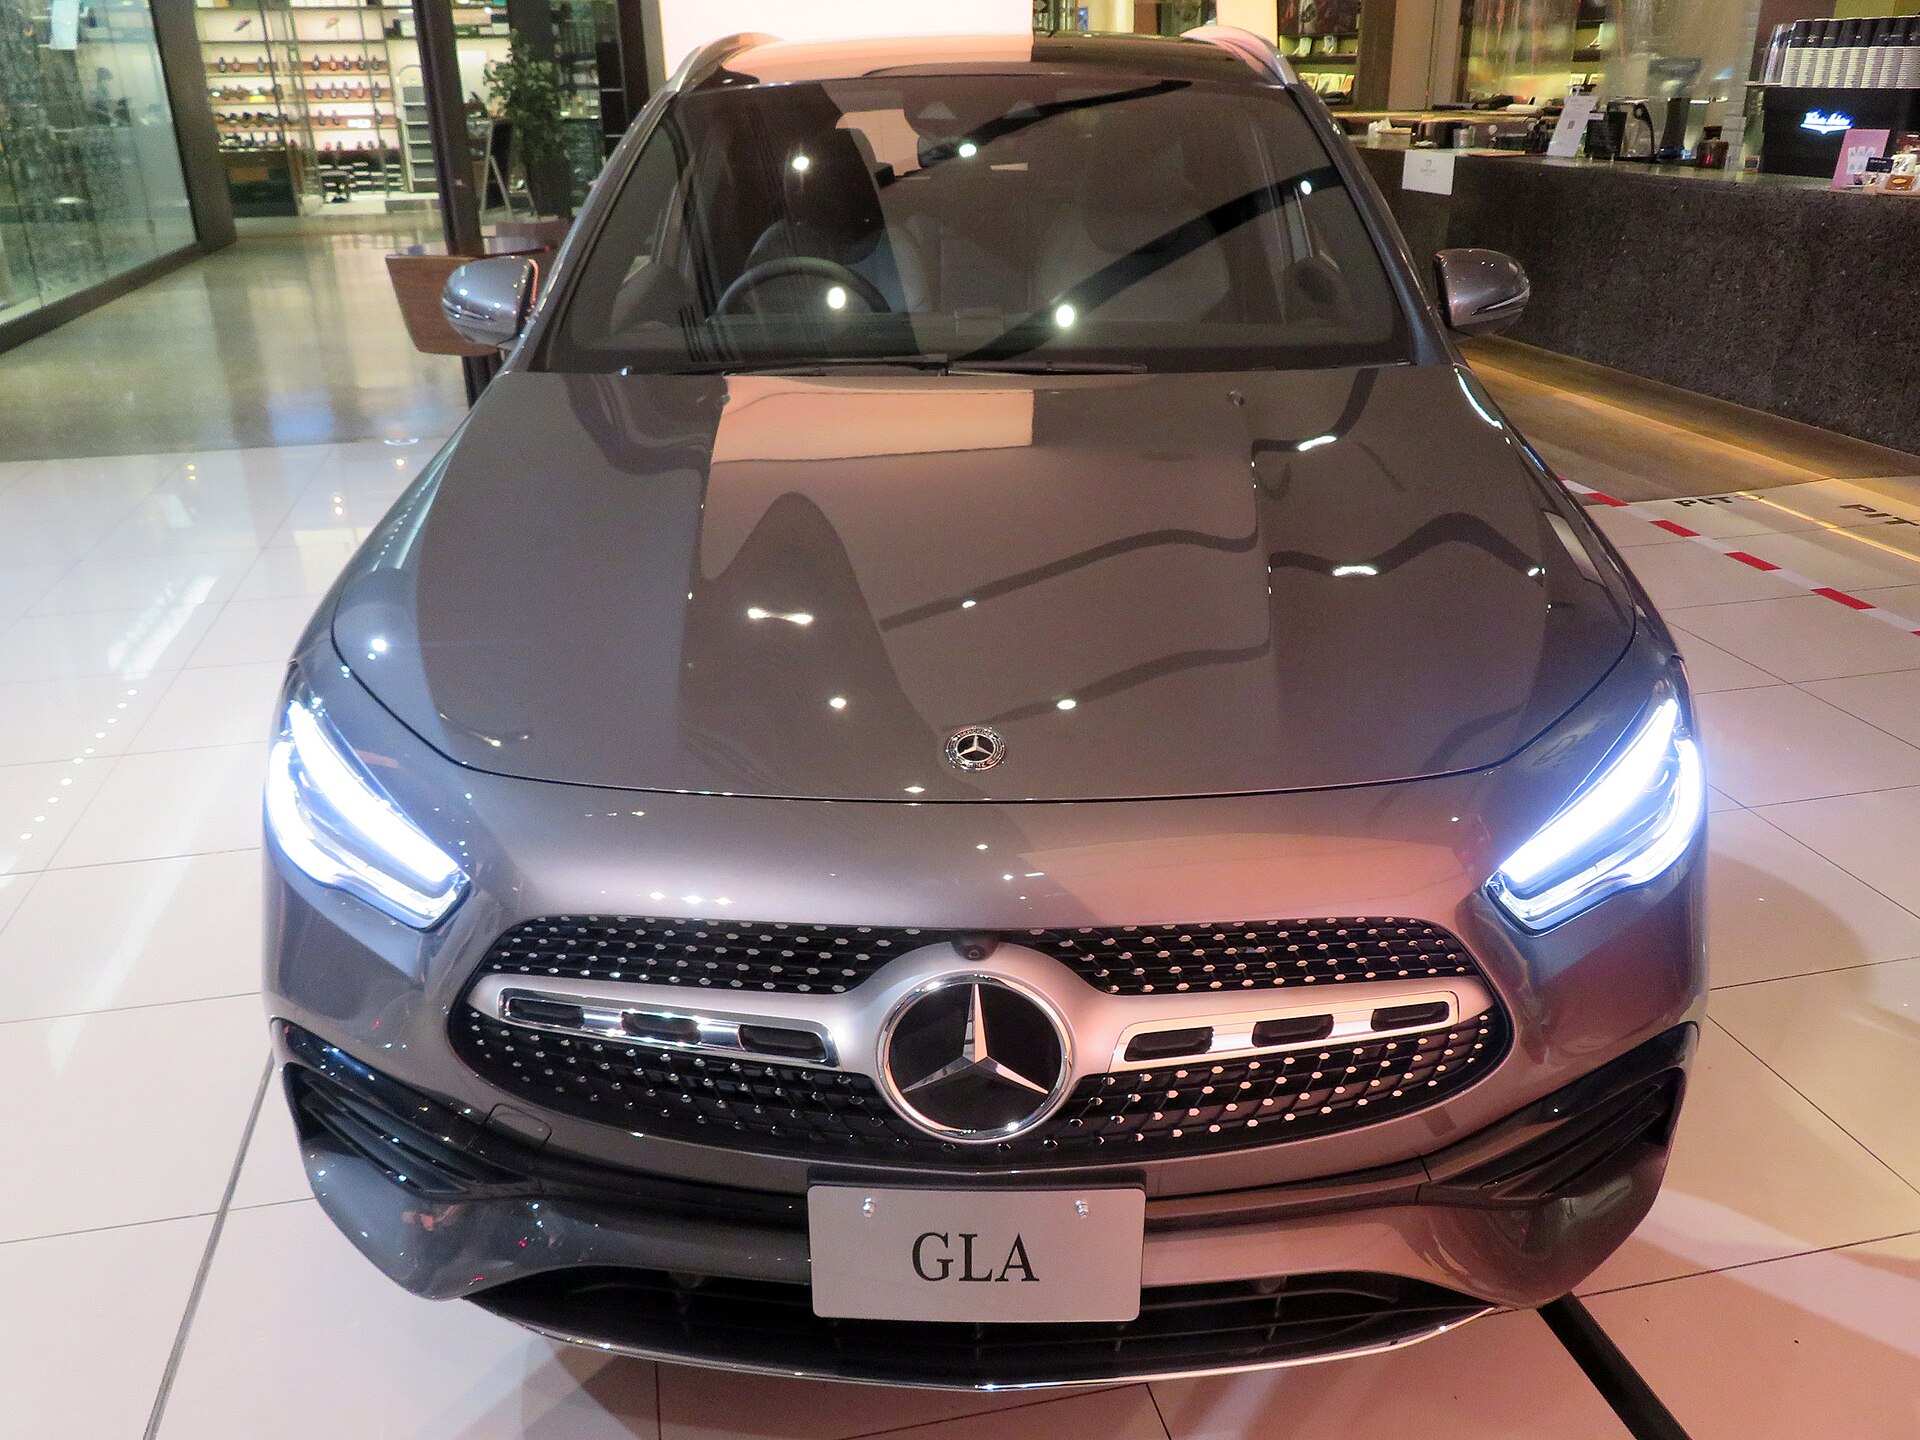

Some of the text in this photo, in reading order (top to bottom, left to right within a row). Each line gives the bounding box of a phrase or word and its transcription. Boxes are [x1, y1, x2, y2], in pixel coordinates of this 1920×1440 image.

[1673, 497, 1734, 508] PIT
[1839, 503, 1920, 527] PIT
[911, 1231, 1041, 1283] GLA
